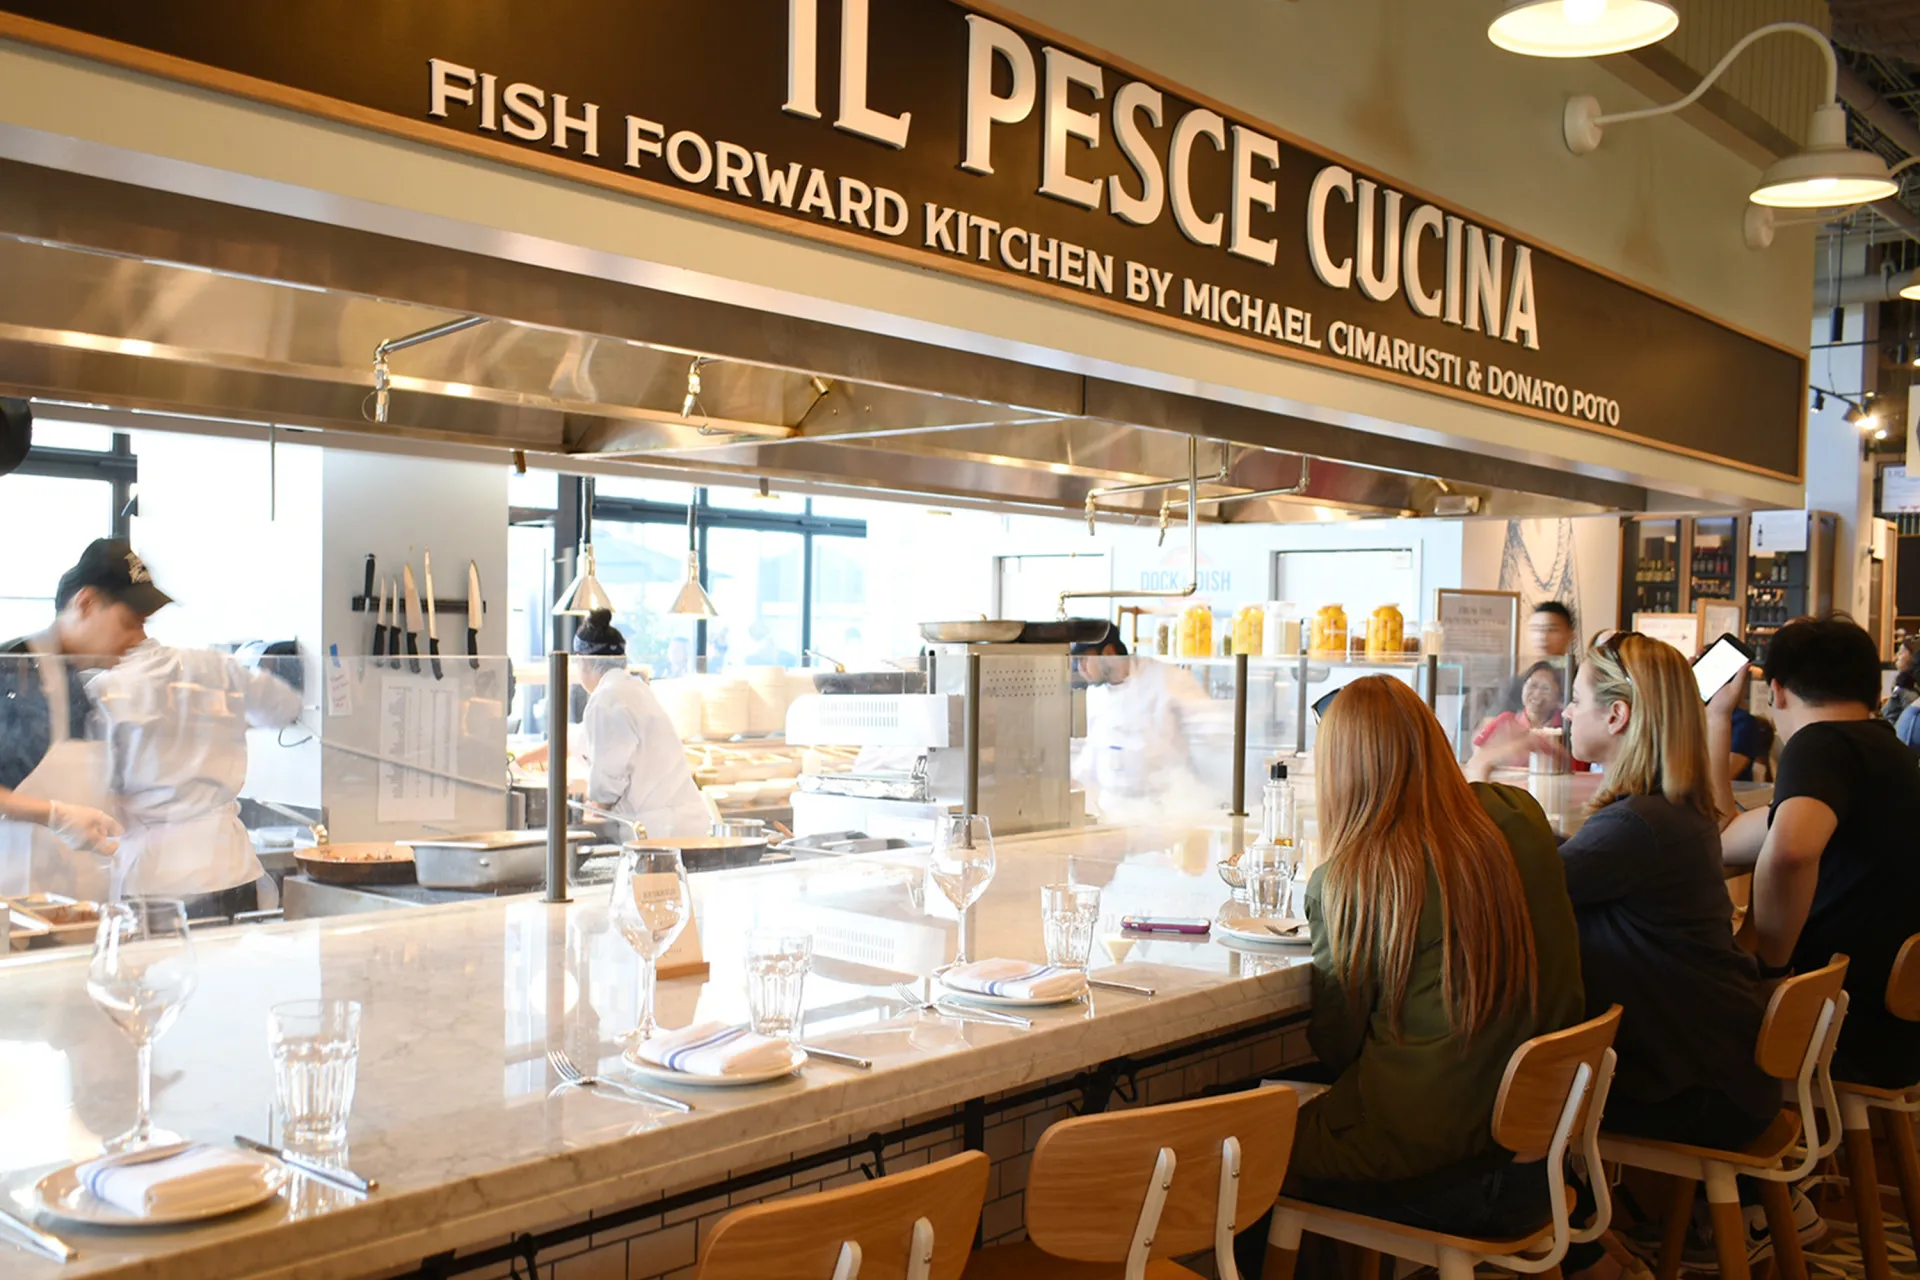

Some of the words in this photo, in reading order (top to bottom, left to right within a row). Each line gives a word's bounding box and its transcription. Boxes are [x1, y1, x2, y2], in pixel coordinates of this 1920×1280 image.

[427, 57, 600, 158] FISH
[623, 114, 910, 237] FORWARD
[924, 201, 1115, 295] KITCHEN
[1126, 260, 1174, 308] BY
[1182, 278, 1323, 350] MICHAEL
[1328, 319, 1462, 387] CIMARUSTI
[1466, 360, 1483, 392] &
[1487, 365, 1570, 414] DONATO
[1572, 388, 1621, 427] POTO
[782, 0, 912, 149] IL
[959, 13, 1280, 267] PESCE
[1307, 165, 1541, 351] CUCINA
